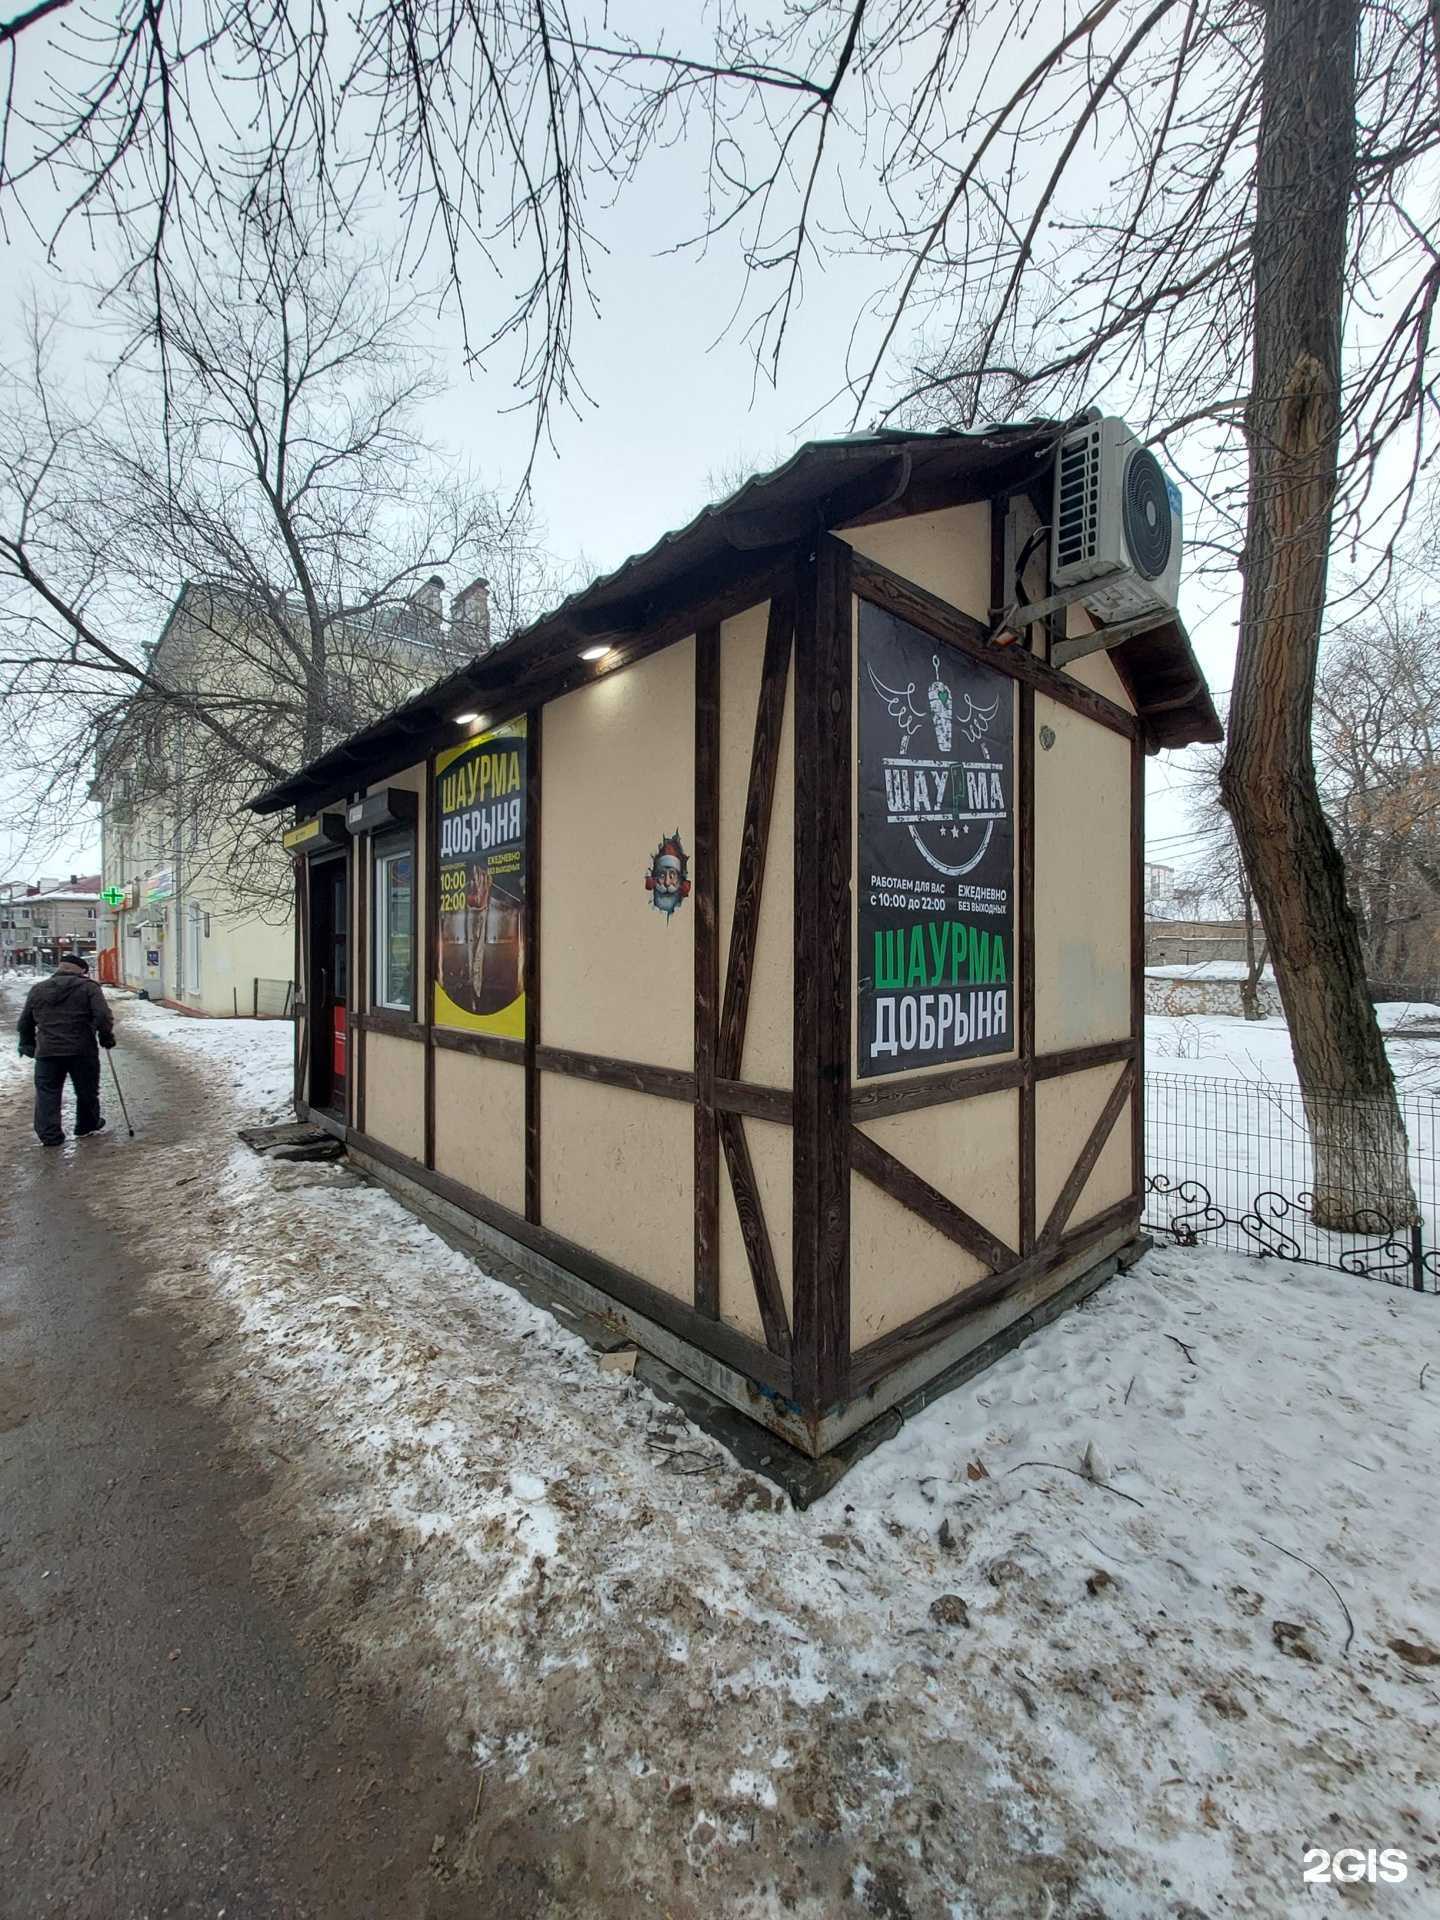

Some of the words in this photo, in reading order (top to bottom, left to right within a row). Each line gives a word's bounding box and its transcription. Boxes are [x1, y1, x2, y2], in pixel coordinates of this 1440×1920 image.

[442, 751, 520, 814] ШАУРМА
[440, 798, 521, 858] ДОБРЫНЯ
[441, 870, 466, 891] 10:00
[871, 875, 914, 891] РАБОТАЕМ
[914, 881, 930, 894] ДЛЯ
[931, 884, 945, 894] ВАС
[440, 892, 466, 912] 22:00
[878, 893, 906, 908] 10:00
[921, 897, 946, 911] 22:00
[958, 884, 1007, 901] ЕЖЕДНЕВНО
[958, 901, 971, 911] БЕЗ
[971, 902, 1007, 915] ВЫХОДНЫХ
[874, 921, 1007, 990] ШАУРМА
[870, 989, 1007, 1058] ДОБРЫНЯ
